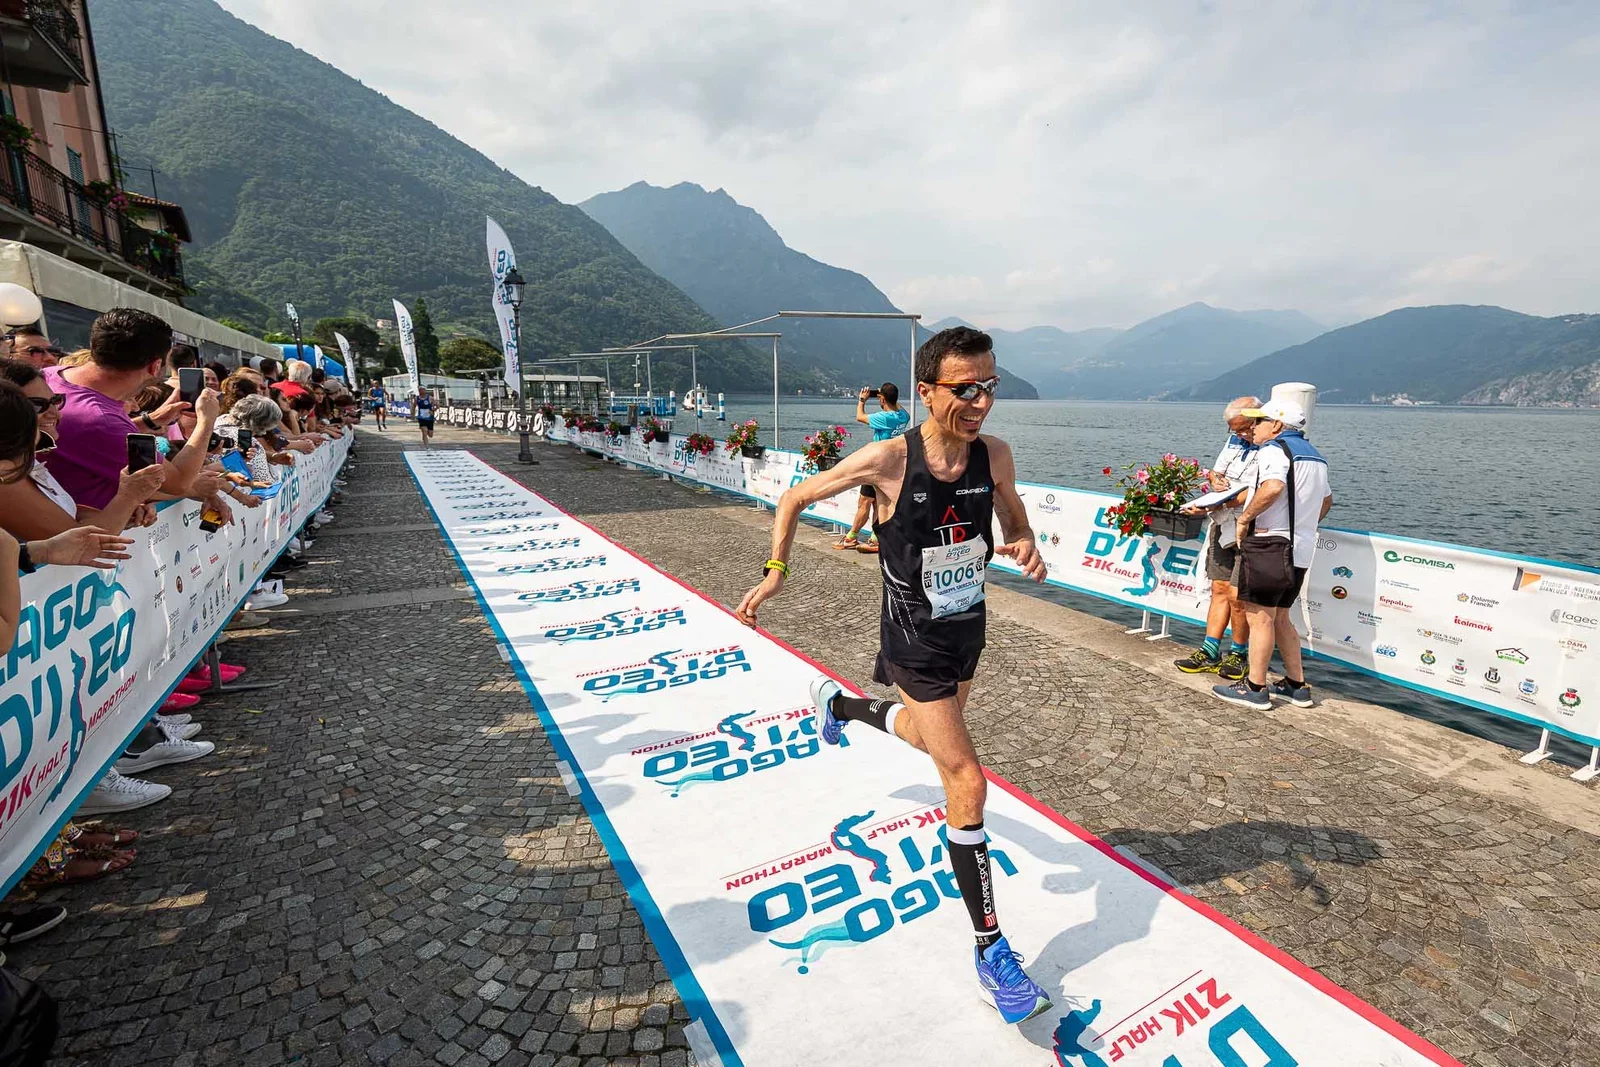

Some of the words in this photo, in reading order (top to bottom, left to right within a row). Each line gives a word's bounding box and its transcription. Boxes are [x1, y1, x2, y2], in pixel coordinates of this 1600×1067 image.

[1082, 556, 1114, 572] 21K
[1114, 567, 1141, 579] HALF
[1403, 555, 1455, 570] COMISA
[934, 563, 975, 590] 1006
[0, 571, 103, 687] AGO
[588, 618, 687, 641] LAGO
[1454, 615, 1493, 632] italmark
[705, 645, 741, 656] 21K
[576, 661, 647, 679] MARATHON
[637, 662, 752, 694] LAGO
[35, 741, 69, 790] HALF
[88, 671, 137, 732] MARATHON
[744, 714, 781, 728] HALF
[631, 730, 716, 756] MARATHON
[867, 821, 911, 840] HALF
[726, 846, 833, 891] MARATHON
[1170, 977, 1233, 1037] 21K
[1108, 1016, 1163, 1062] HALF
